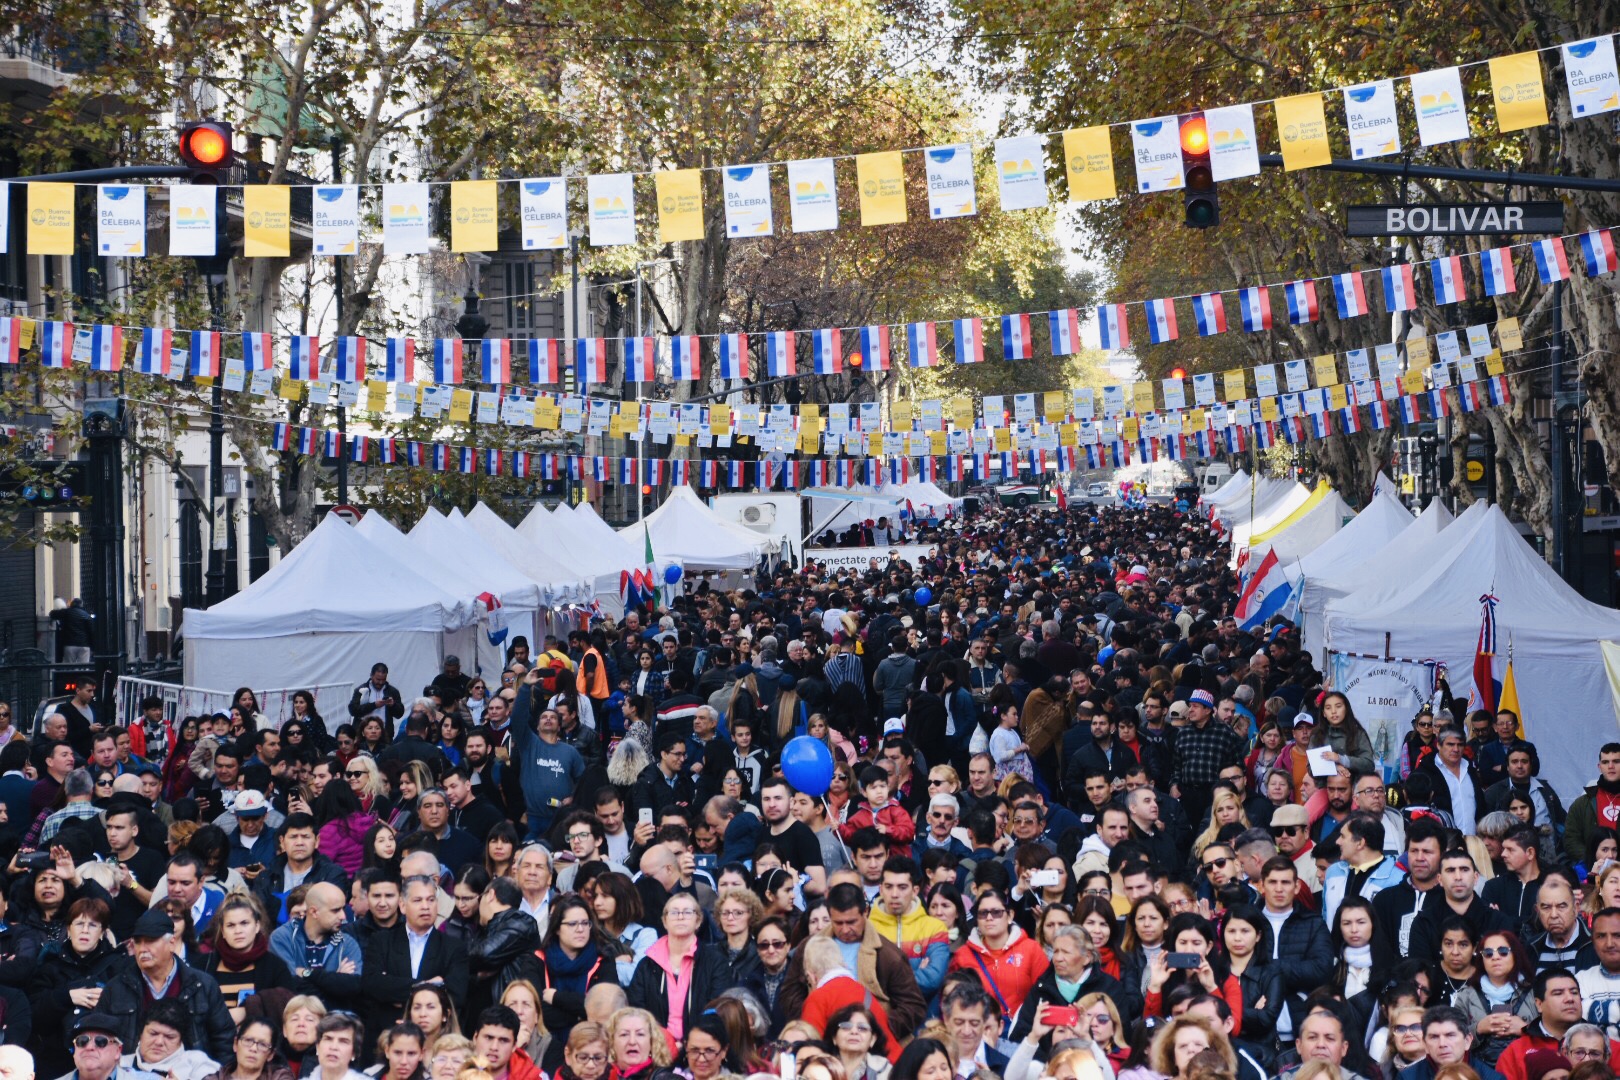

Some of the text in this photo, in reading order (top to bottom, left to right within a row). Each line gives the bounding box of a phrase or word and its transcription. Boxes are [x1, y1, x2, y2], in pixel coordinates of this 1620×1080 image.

[1571, 70, 1583, 78] BA
[1572, 72, 1614, 86] CELEBRA
[1352, 117, 1392, 130] CELEBRA
[1138, 152, 1178, 164] CELEBRA
[931, 180, 969, 189] CELEBRA
[729, 199, 766, 207] CELEBRA
[1386, 207, 1523, 232] BOLIVAR
[63, 489, 67, 497] E
[813, 556, 866, 565] Conectate
[1368, 669, 1387, 678] MADRE
[1379, 698, 1397, 706] BOCA
